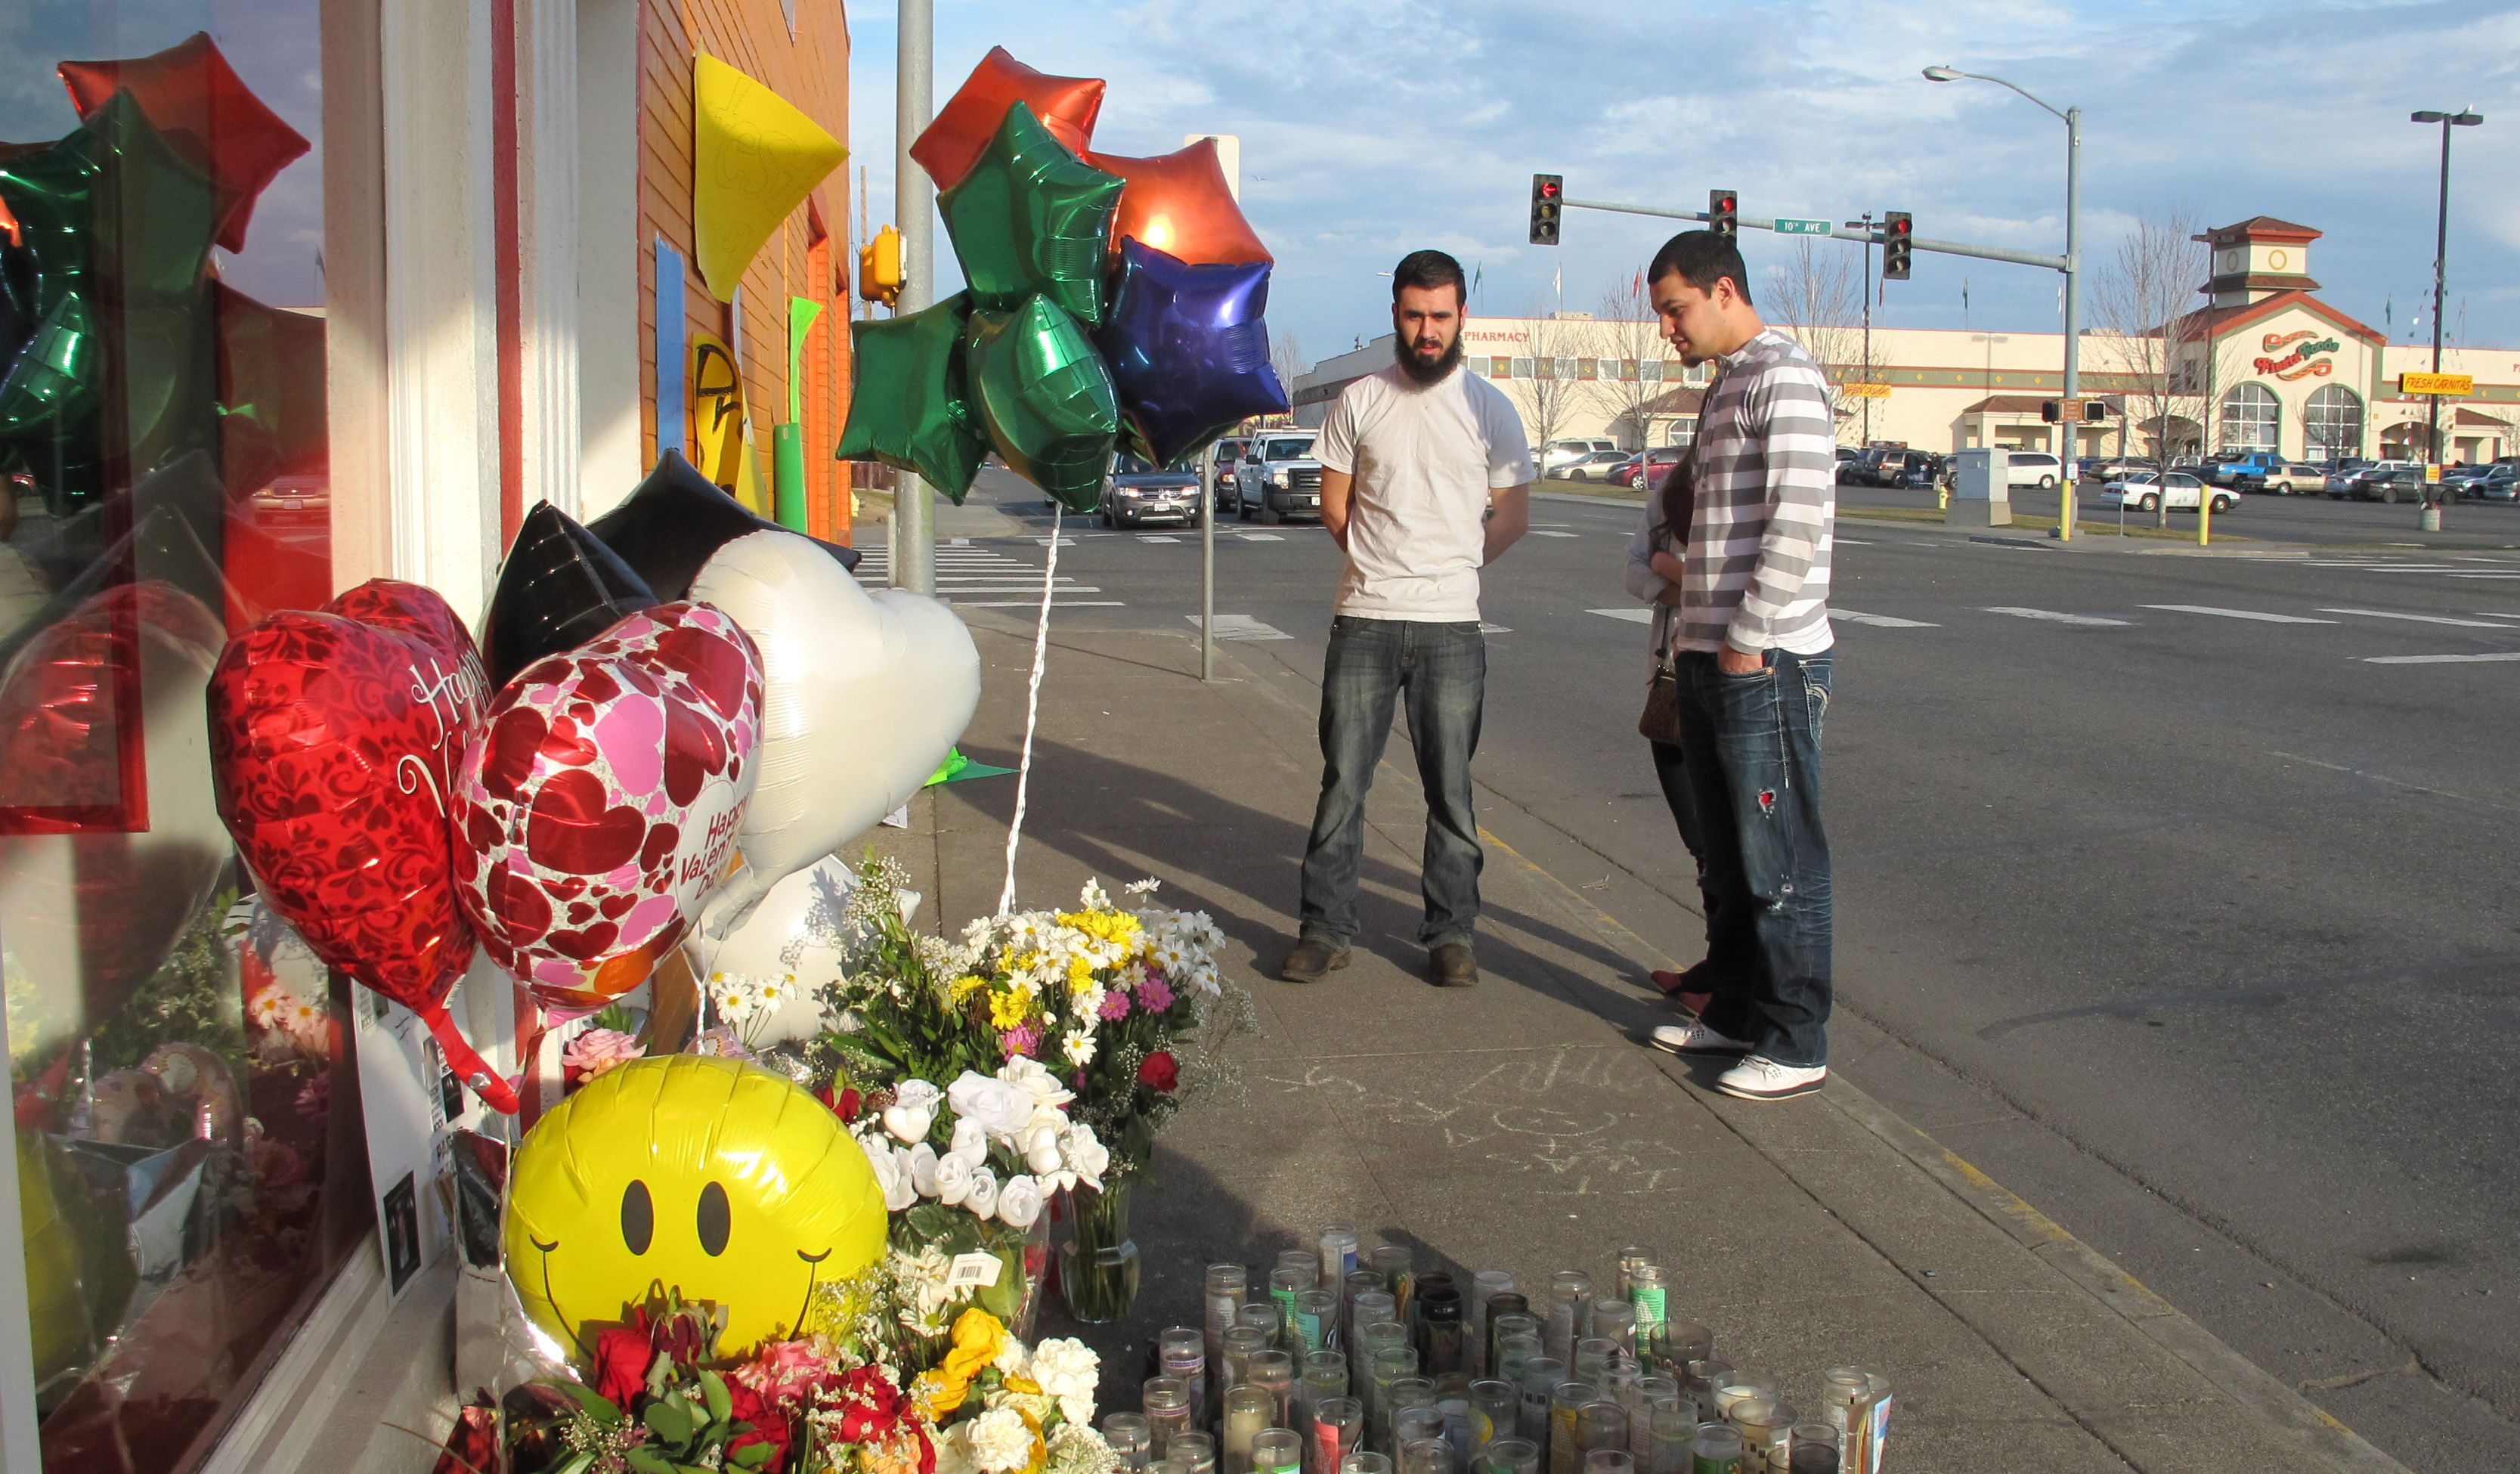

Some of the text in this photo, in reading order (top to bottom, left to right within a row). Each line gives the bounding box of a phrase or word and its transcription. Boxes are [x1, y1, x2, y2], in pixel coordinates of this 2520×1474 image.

[1804, 222, 1821, 233] AVE
[1464, 331, 1531, 342] PHARMACY
[2253, 337, 2340, 376] Fiesta Foods
[2405, 376, 2472, 391] FRESH CARNITAS
